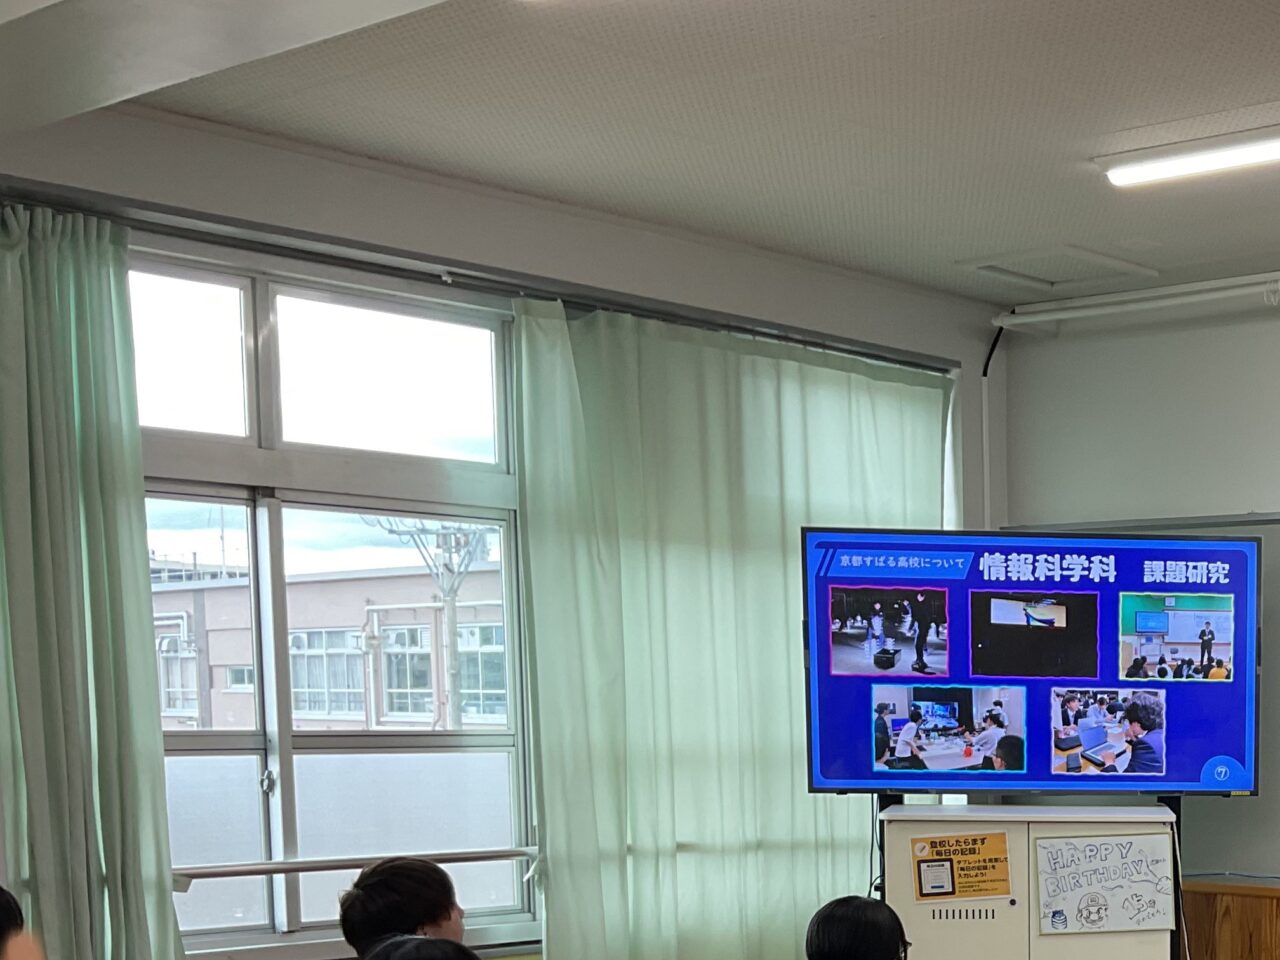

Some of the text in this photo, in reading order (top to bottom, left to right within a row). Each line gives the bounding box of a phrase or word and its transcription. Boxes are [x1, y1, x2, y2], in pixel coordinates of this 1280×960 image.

[840, 554, 965, 568] 京都すばる高校について
[979, 552, 1230, 584] 情報科学科 課題研究
[930, 838, 986, 848] 登校したらまず
[931, 848, 980, 857] 「毎日の記録」
[1048, 842, 1132, 870] HAPPY
[1045, 860, 1143, 898] BIRTHDAY
